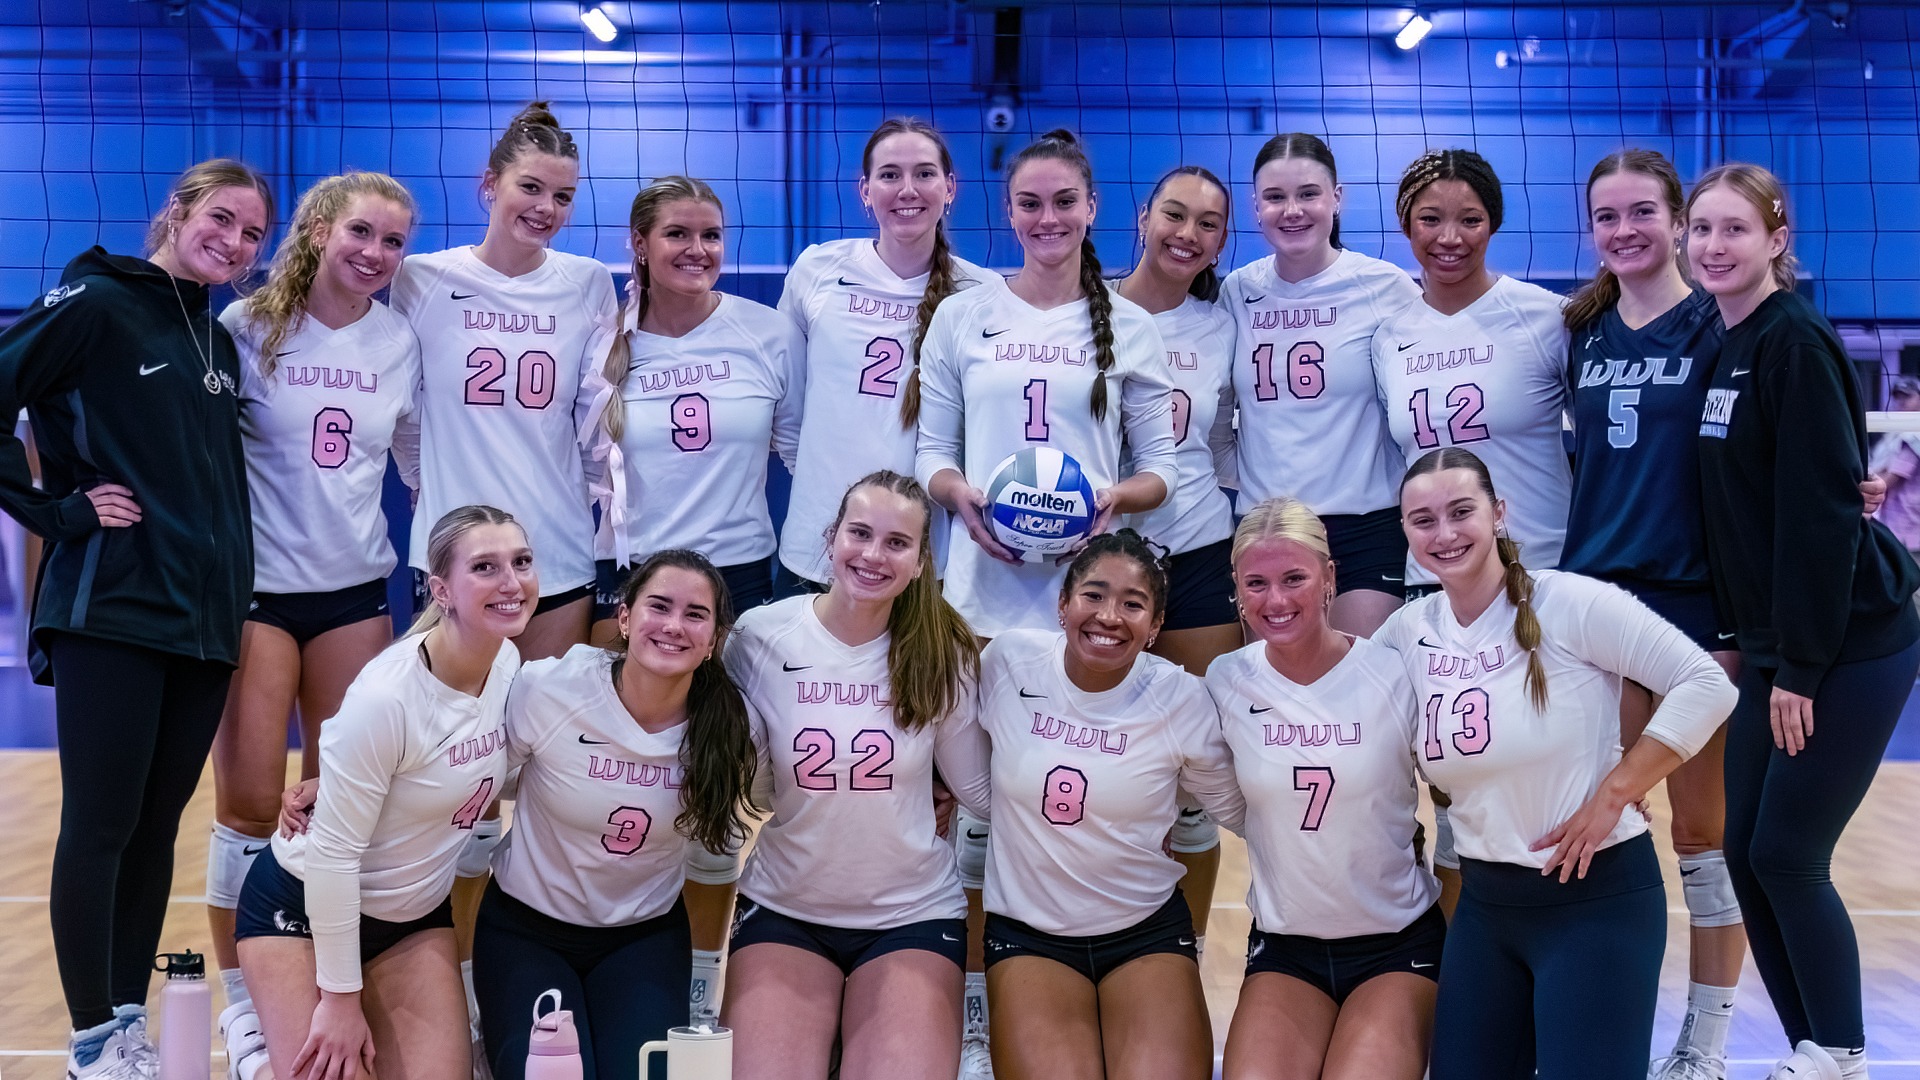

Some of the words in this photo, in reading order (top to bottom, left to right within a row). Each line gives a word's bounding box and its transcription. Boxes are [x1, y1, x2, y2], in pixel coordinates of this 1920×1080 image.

[463, 310, 556, 335] WWU
[848, 293, 920, 322] WW
[1252, 307, 1337, 330] WWU
[286, 366, 378, 393] WWU
[464, 346, 556, 410] 20
[639, 360, 731, 393] WWU
[858, 336, 904, 398] 2
[995, 343, 1087, 367] WWU
[1252, 341, 1325, 402] 16
[1406, 344, 1493, 375] WWU
[1577, 357, 1693, 389] WWU
[671, 392, 711, 452] 9
[1023, 378, 1049, 442] 1
[1409, 383, 1490, 450] 12
[1607, 388, 1641, 449] 5
[312, 407, 353, 469] 6
[1011, 491, 1075, 513] molten
[1012, 512, 1066, 536] NCAA
[1031, 712, 1128, 755] WWU
[1263, 722, 1361, 747] WWU
[1424, 687, 1491, 761] 13
[793, 727, 894, 791] 22
[451, 776, 494, 829] 4
[1041, 764, 1088, 825] 8
[1293, 766, 1335, 831] 7
[601, 805, 652, 856] 3
